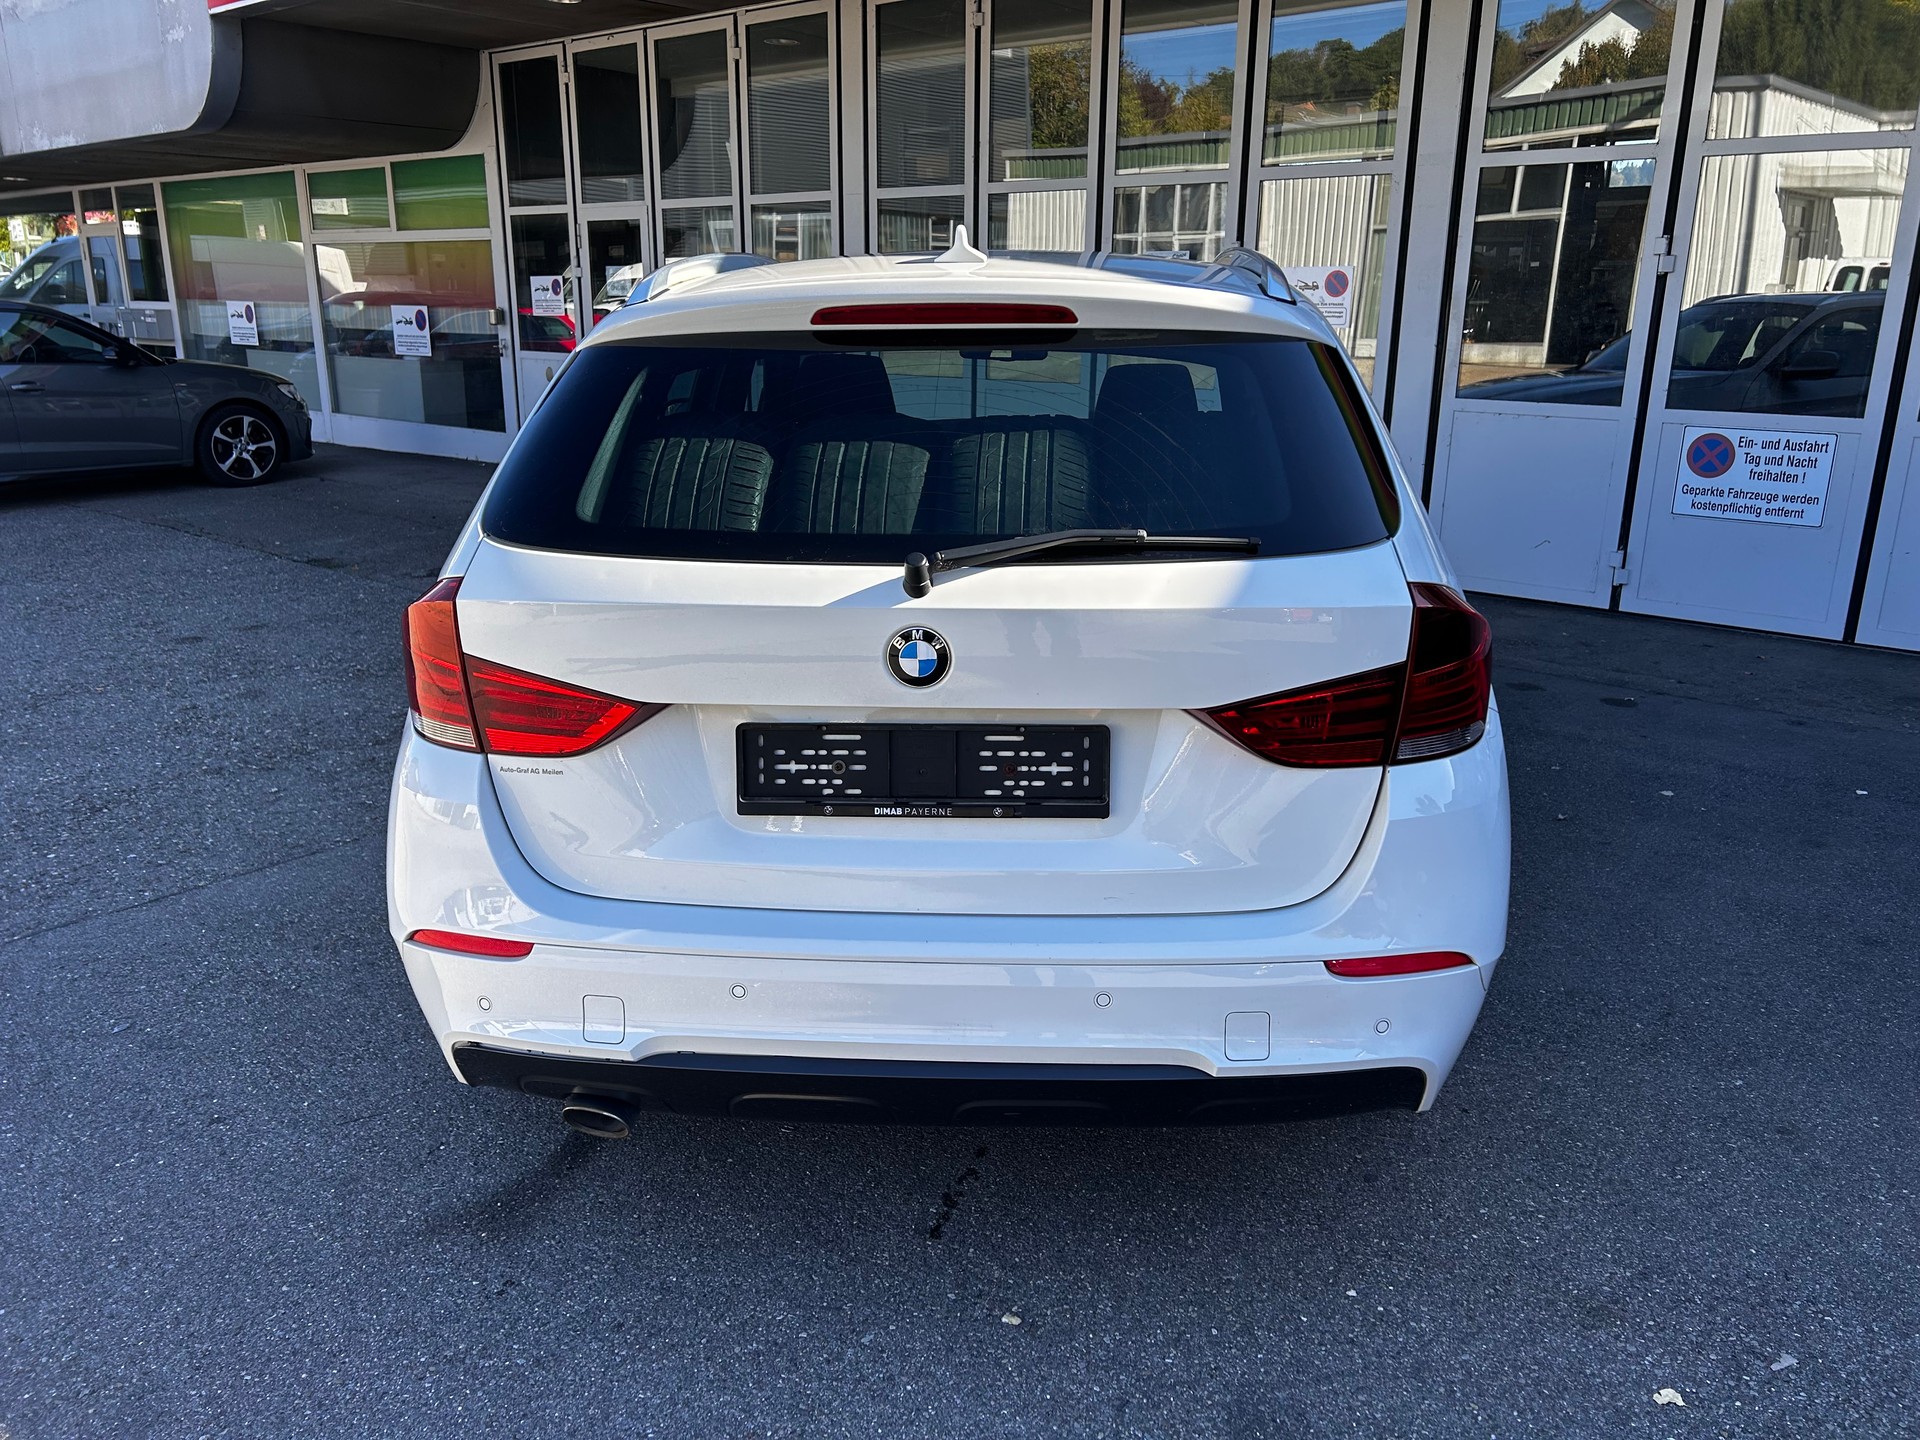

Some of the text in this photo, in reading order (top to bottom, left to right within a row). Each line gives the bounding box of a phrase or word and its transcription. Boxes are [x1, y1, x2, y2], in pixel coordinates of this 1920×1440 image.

[1738, 436, 1829, 454] Ein- und Ausfahrt
[1744, 452, 1818, 469] Tag und Nacht
[1749, 468, 1806, 483] freihalten !
[1682, 484, 1819, 505] Geparkte Fahrzeuge werden
[1691, 499, 1804, 519] kostenpflichtig entfernt
[893, 630, 944, 649] BMW
[904, 808, 952, 816] PAYERNE
